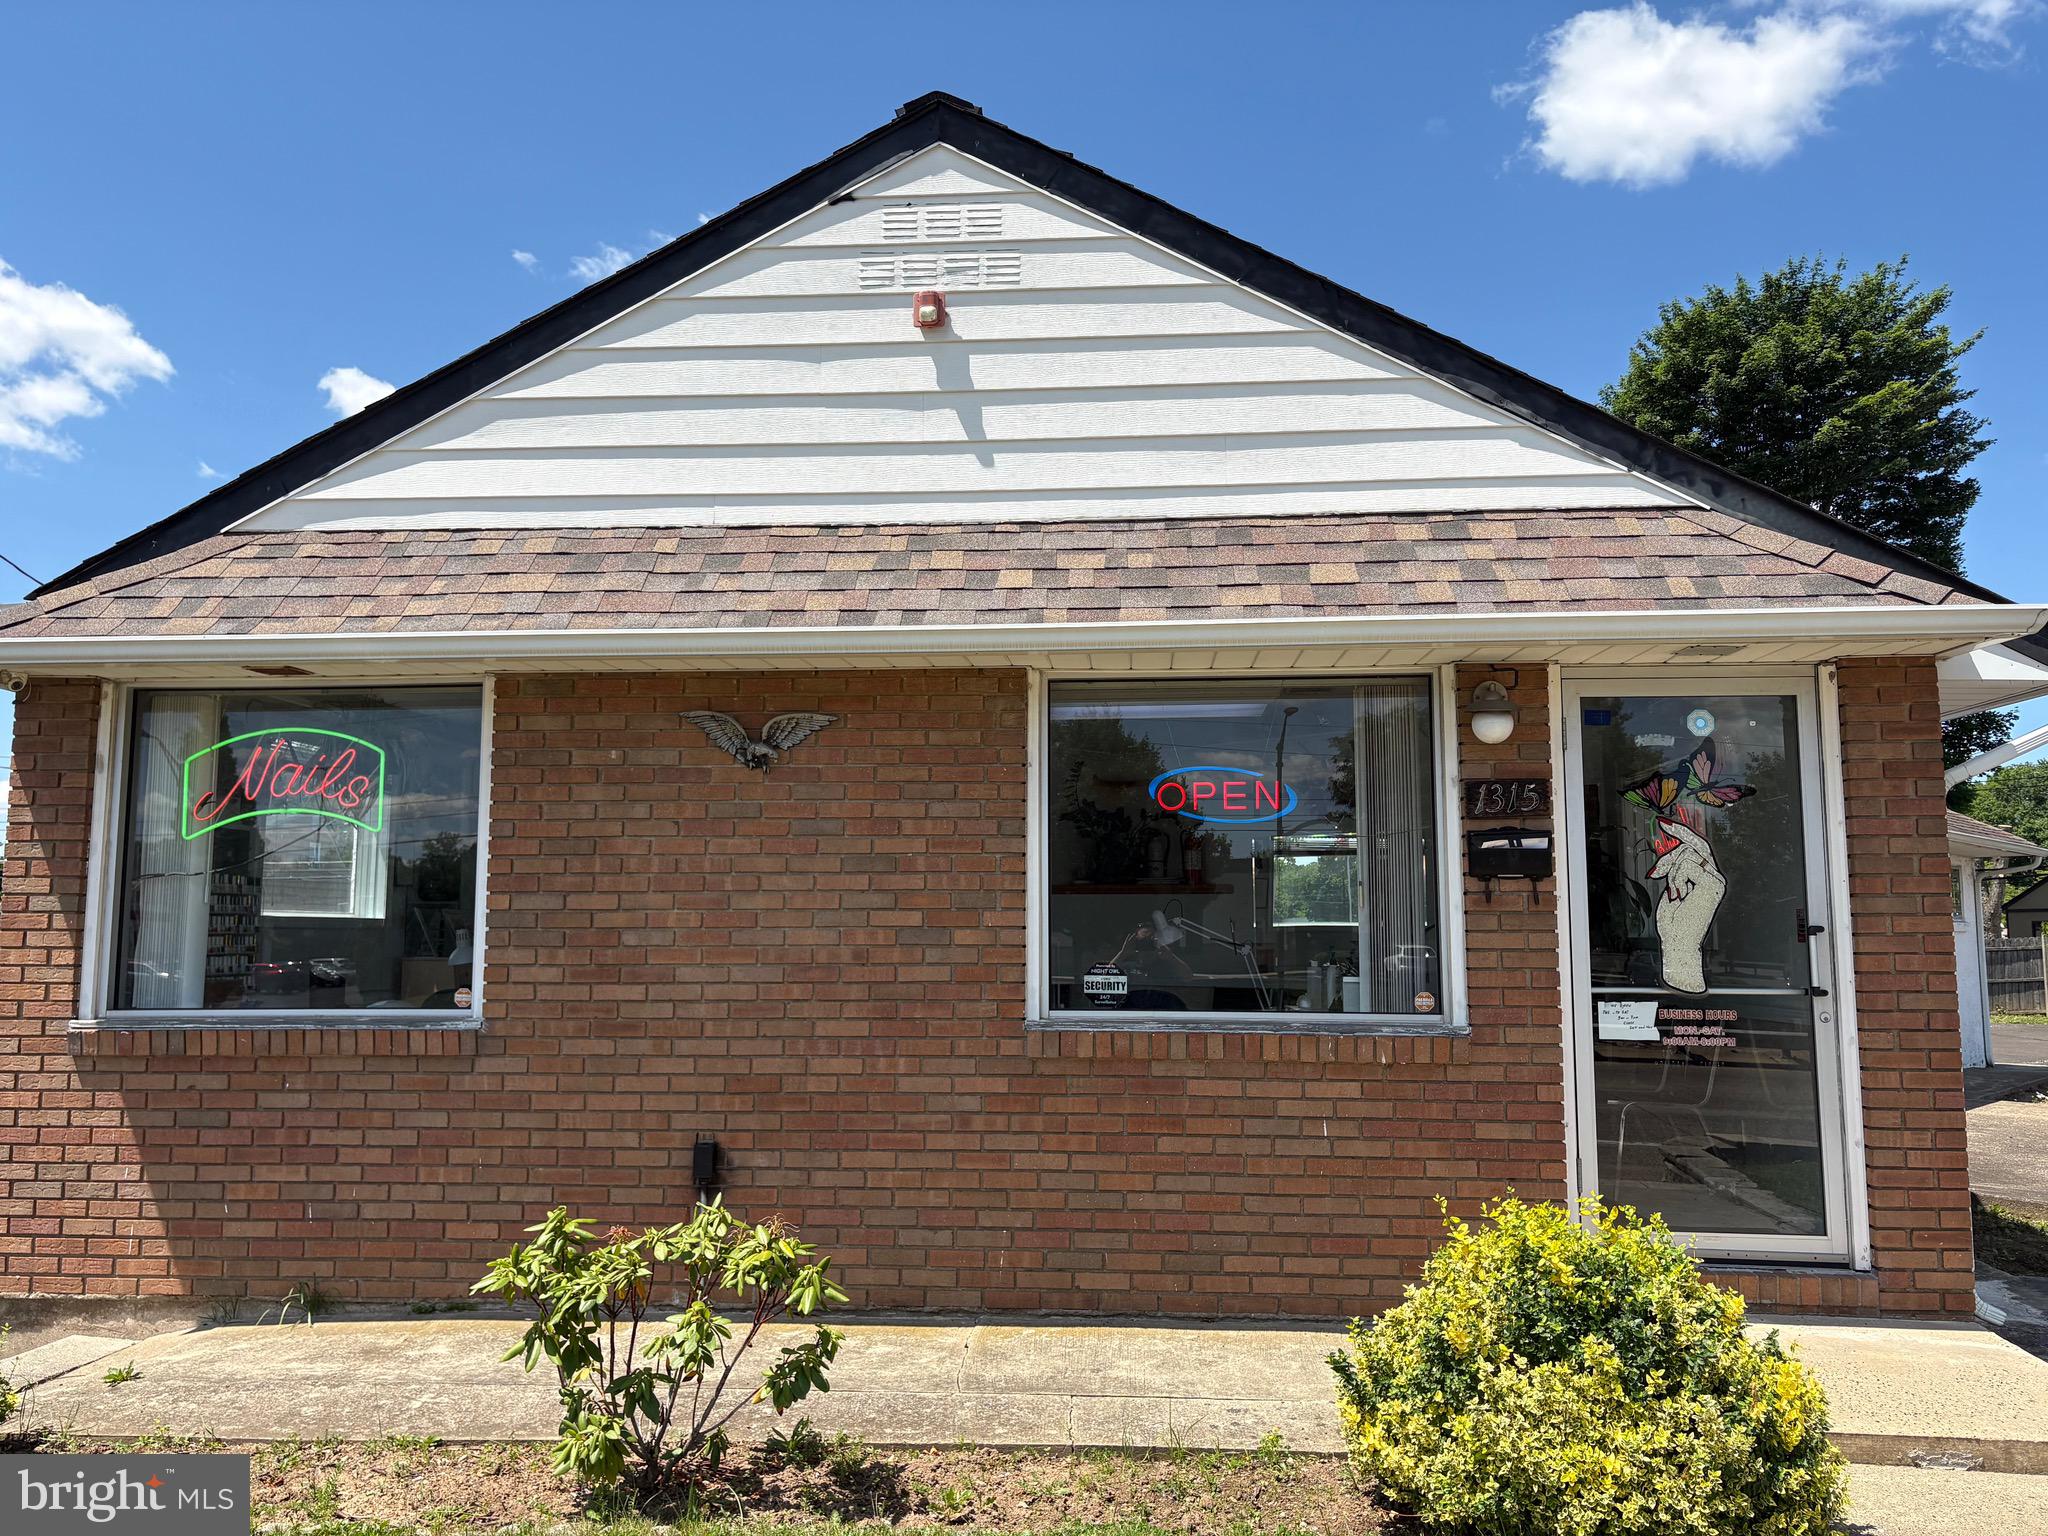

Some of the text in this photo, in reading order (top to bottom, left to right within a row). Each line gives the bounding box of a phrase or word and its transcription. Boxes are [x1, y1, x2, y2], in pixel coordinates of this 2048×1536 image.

[193, 739, 369, 821] Nails
[1157, 780, 1281, 811] OPEN
[1474, 782, 1541, 815] 1315
[1085, 981, 1126, 991] SECURITY
[1658, 1009, 1738, 1021] BUSINESS HOURS
